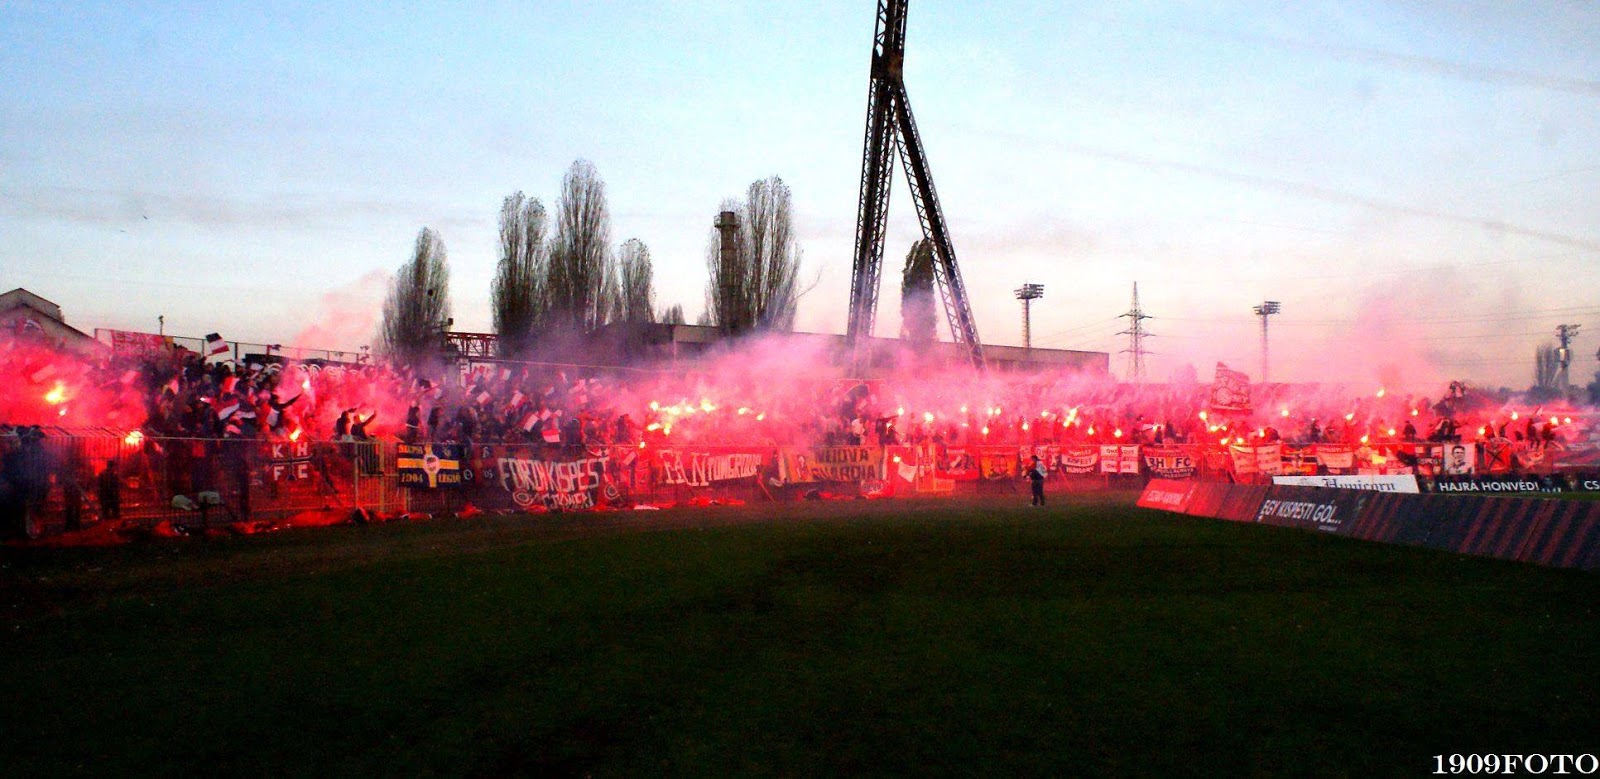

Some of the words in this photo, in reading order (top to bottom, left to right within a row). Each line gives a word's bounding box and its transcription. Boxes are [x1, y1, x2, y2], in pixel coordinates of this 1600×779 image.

[272, 444, 284, 458] K
[297, 442, 308, 456] H
[273, 466, 285, 480] F
[1439, 479, 1478, 492] HAJRÁ
[1481, 479, 1540, 492] HONVÉD!
[1260, 500, 1281, 515] EGY
[1276, 501, 1316, 519] KISPESTI
